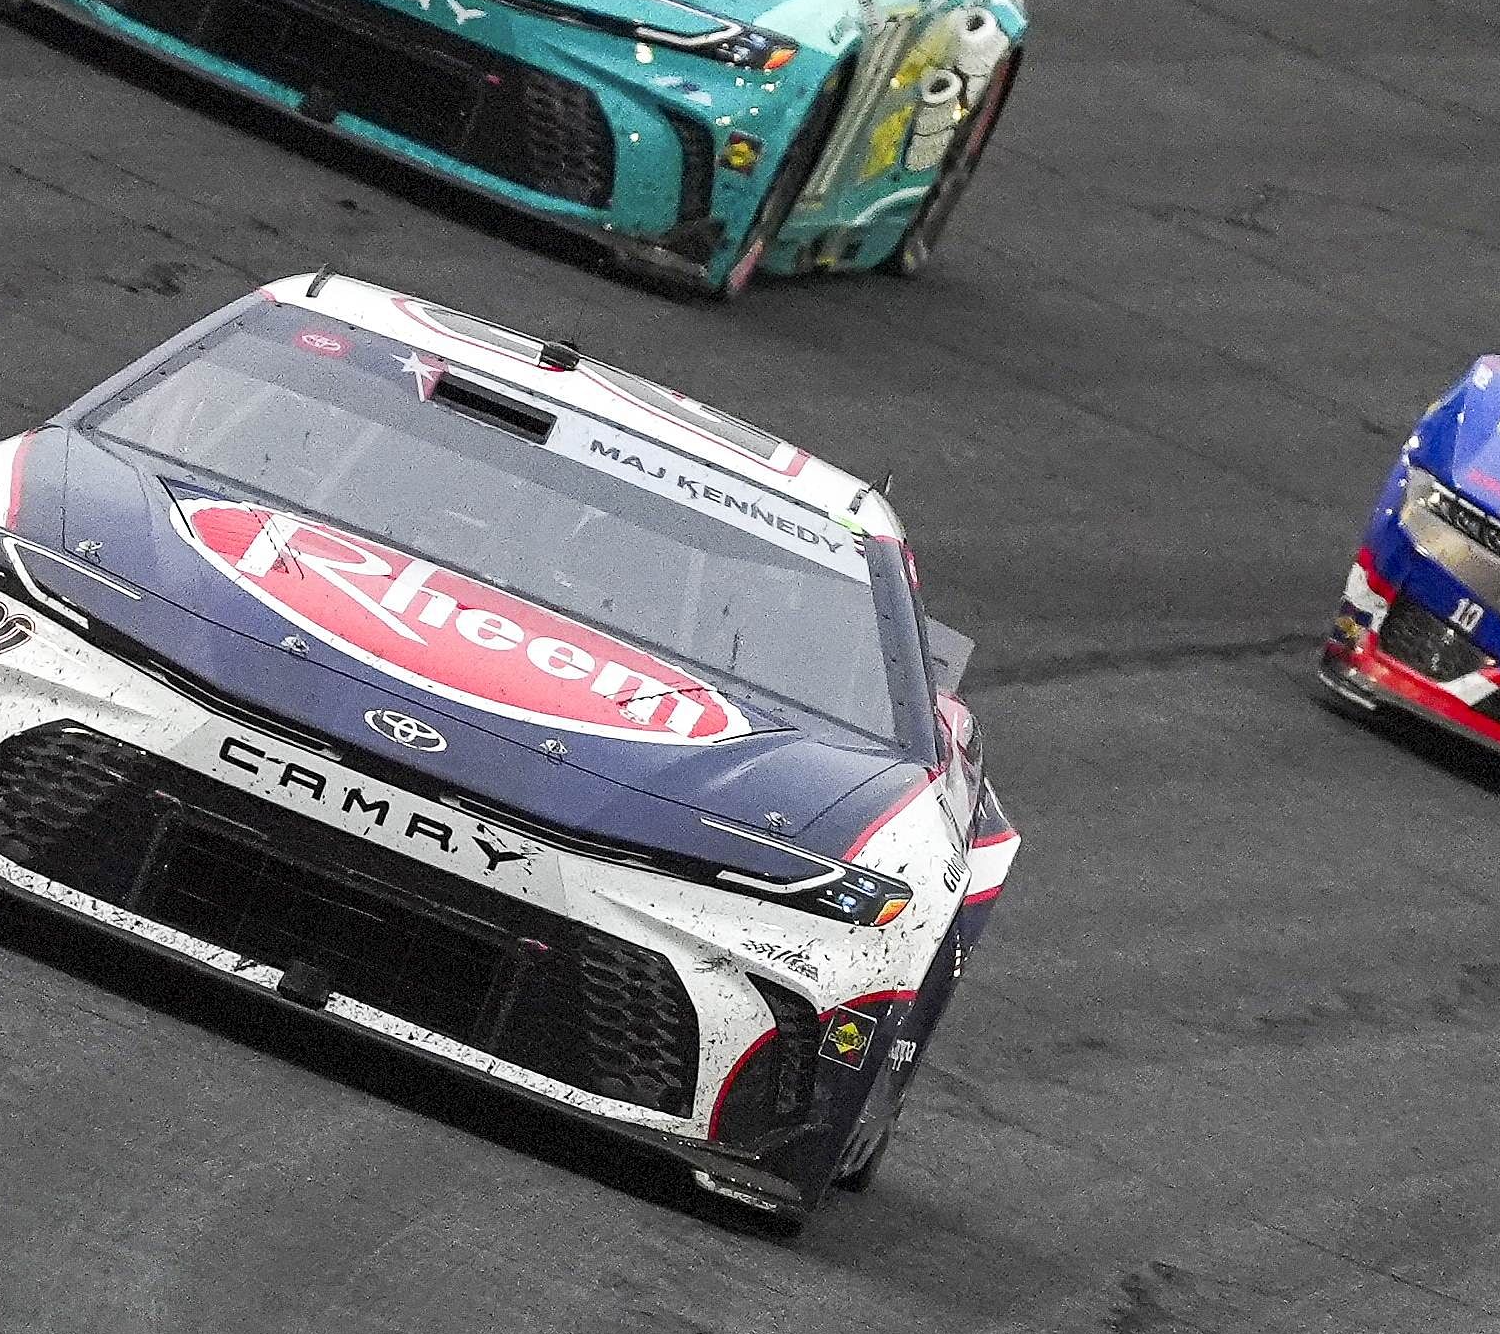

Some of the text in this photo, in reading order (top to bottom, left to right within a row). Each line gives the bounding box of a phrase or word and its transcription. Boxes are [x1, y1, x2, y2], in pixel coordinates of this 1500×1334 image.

[590, 439, 844, 554] MAJ KENNEDY
[234, 512, 706, 739] Rheem
[219, 736, 528, 872] CAMRY
